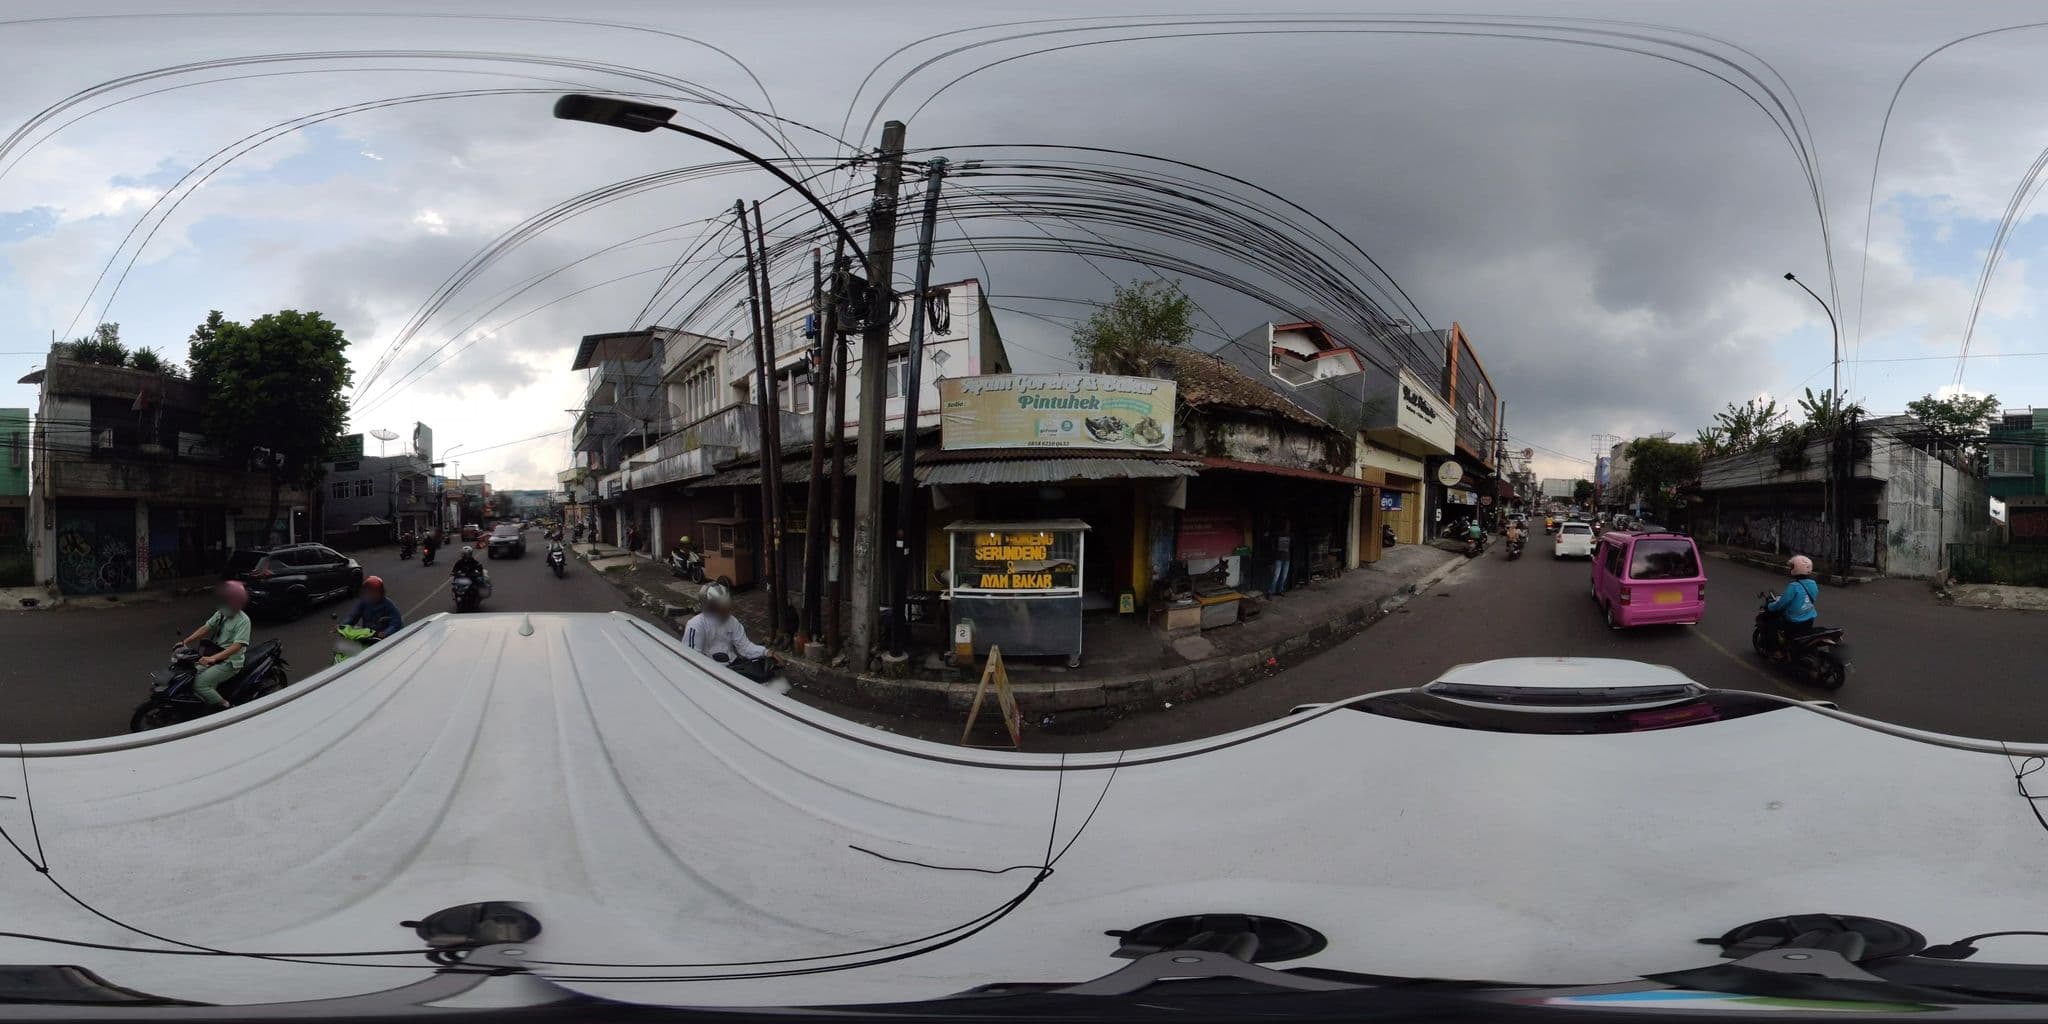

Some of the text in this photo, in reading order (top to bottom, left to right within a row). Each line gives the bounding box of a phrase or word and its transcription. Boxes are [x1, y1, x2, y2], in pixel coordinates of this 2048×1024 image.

[1017, 394, 1100, 410] Pintuhek
[976, 531, 1054, 546] YAM ORENG
[975, 546, 1047, 560] SERUNDENG
[1007, 561, 1016, 574] &
[980, 574, 1053, 588] AYAM BAKAR
[959, 629, 966, 637] 2
